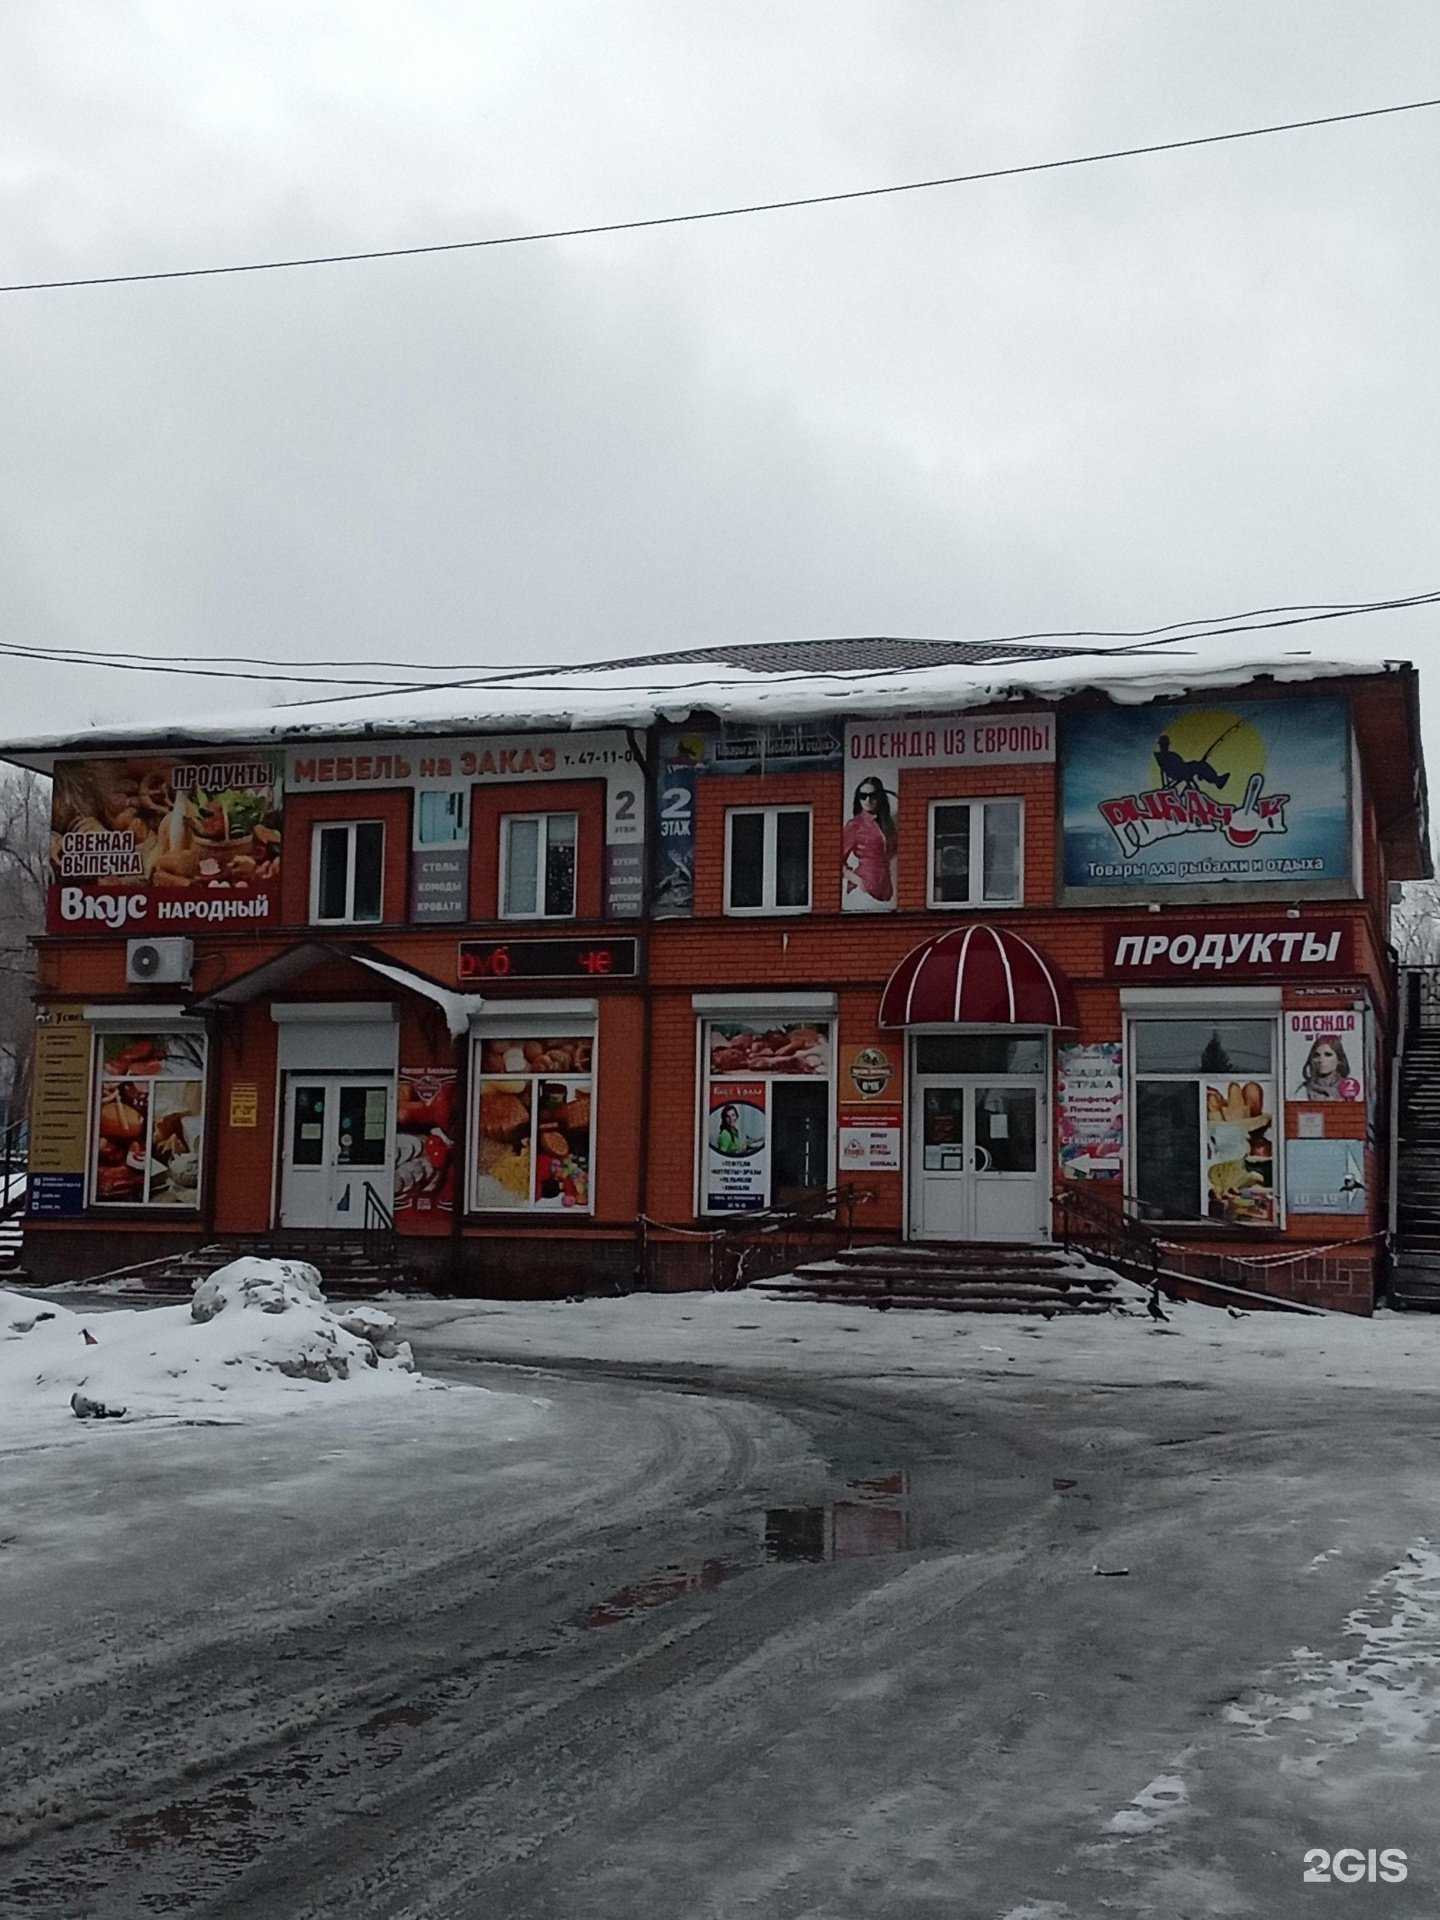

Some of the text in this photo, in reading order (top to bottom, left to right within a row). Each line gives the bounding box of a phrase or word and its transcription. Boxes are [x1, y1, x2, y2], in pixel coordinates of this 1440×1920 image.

[850, 724, 1050, 760] ОДЕЖДА ИЗ ЕВРОПЫ
[172, 763, 275, 790] ПРОДУКТЫ
[294, 755, 411, 783] МЕБЕЛЬ
[419, 757, 452, 777] на
[460, 748, 556, 777] ЗАКАЗ
[578, 750, 636, 764] 47-11-0
[615, 791, 636, 820] 2
[660, 787, 692, 818] 2
[661, 818, 691, 837] ЭТАЖ
[62, 831, 135, 853] СВЕЖАЯ
[61, 854, 143, 876] ВЫПЕЧКА
[422, 862, 459, 872] СТОЛЫ
[1088, 857, 1323, 878] Товары для рыбалки и отдыха
[418, 882, 461, 892] КОМОДЫ
[60, 887, 269, 927] Вкус НАРОДНЫЙ
[417, 902, 461, 912] КРОВАТИ
[1114, 931, 1342, 969] ПРОДУКТЫ
[1292, 1015, 1355, 1032] ОДЕЖДА
